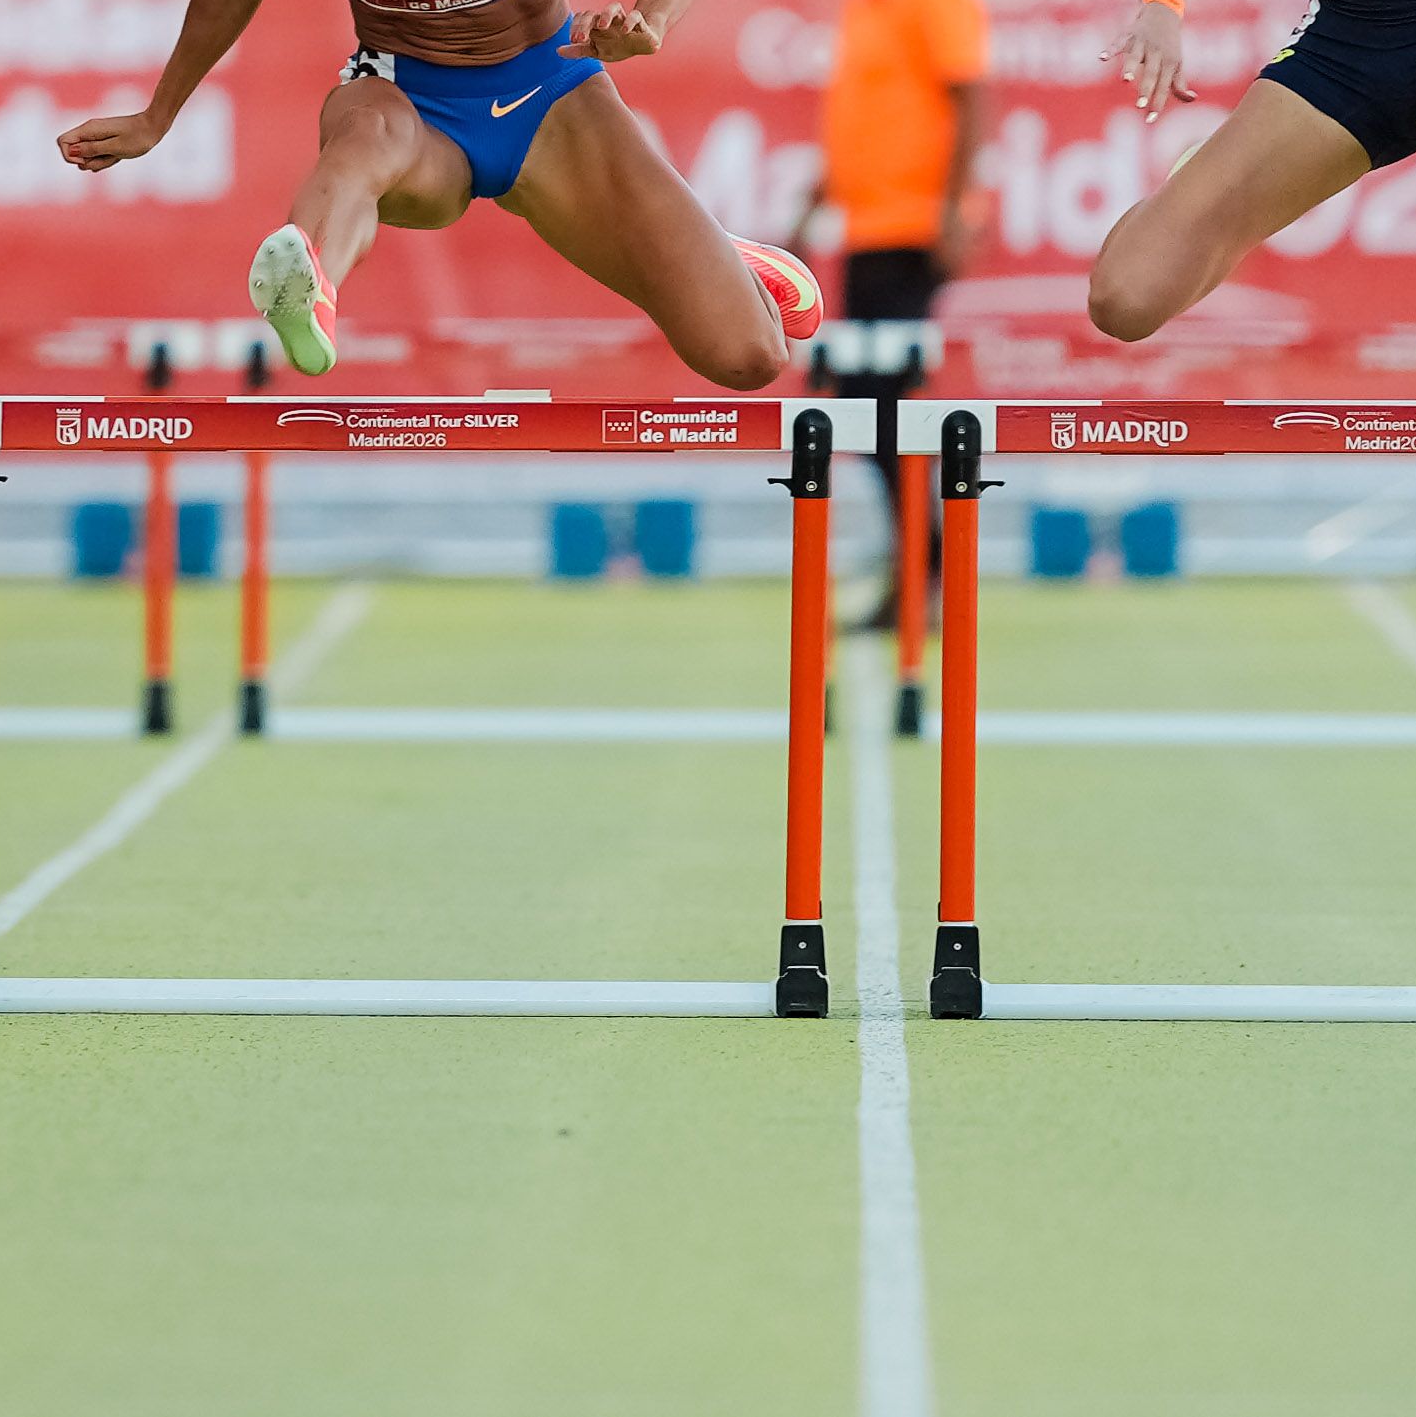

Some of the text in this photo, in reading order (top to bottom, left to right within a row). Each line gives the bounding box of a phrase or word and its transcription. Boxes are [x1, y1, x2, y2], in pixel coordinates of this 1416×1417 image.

[346, 413, 519, 429] Continental Tour SILVER
[639, 410, 738, 424] Comunidad
[87, 417, 193, 444] MADRID
[639, 428, 738, 443] de Madrid
[1082, 421, 1188, 447] MADRID
